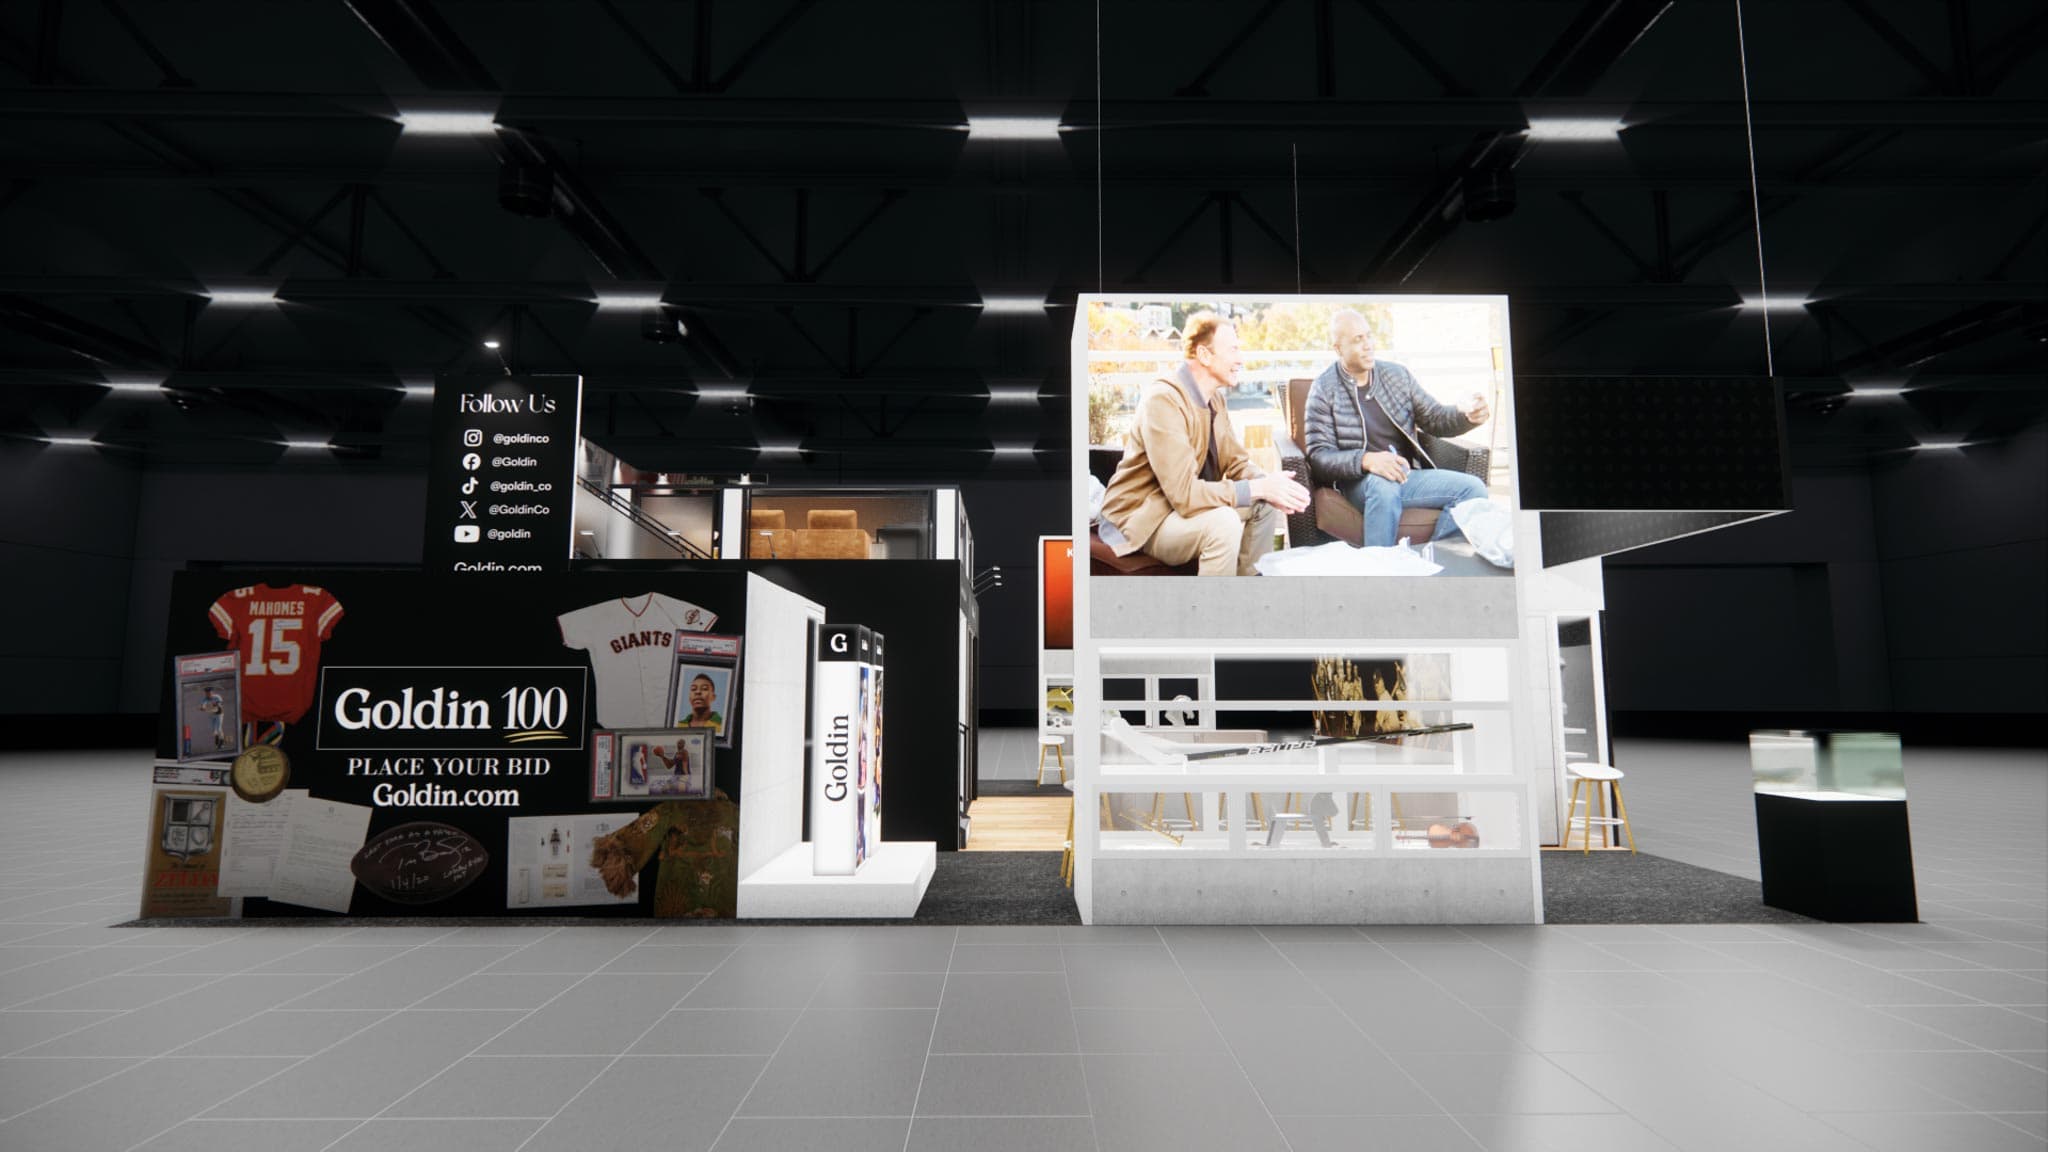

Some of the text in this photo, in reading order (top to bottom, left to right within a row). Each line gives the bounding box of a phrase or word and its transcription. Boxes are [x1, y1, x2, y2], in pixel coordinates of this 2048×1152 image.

[460, 393, 556, 413] Follow Us
[493, 433, 550, 445] @goldinco
[492, 457, 537, 467] @Goldin
[490, 481, 552, 493] @goldin_co
[488, 504, 550, 515] @GoldinCo
[487, 529, 531, 540] @goldin
[249, 601, 305, 616] MAHOMES
[245, 618, 303, 675] 15
[610, 630, 673, 654] GIANTS
[830, 633, 848, 653] G
[334, 686, 569, 730] Goldin 100
[346, 758, 551, 776] PLACE YOUR BID
[824, 714, 849, 802] Goldin
[372, 783, 520, 806] Goldin.com
